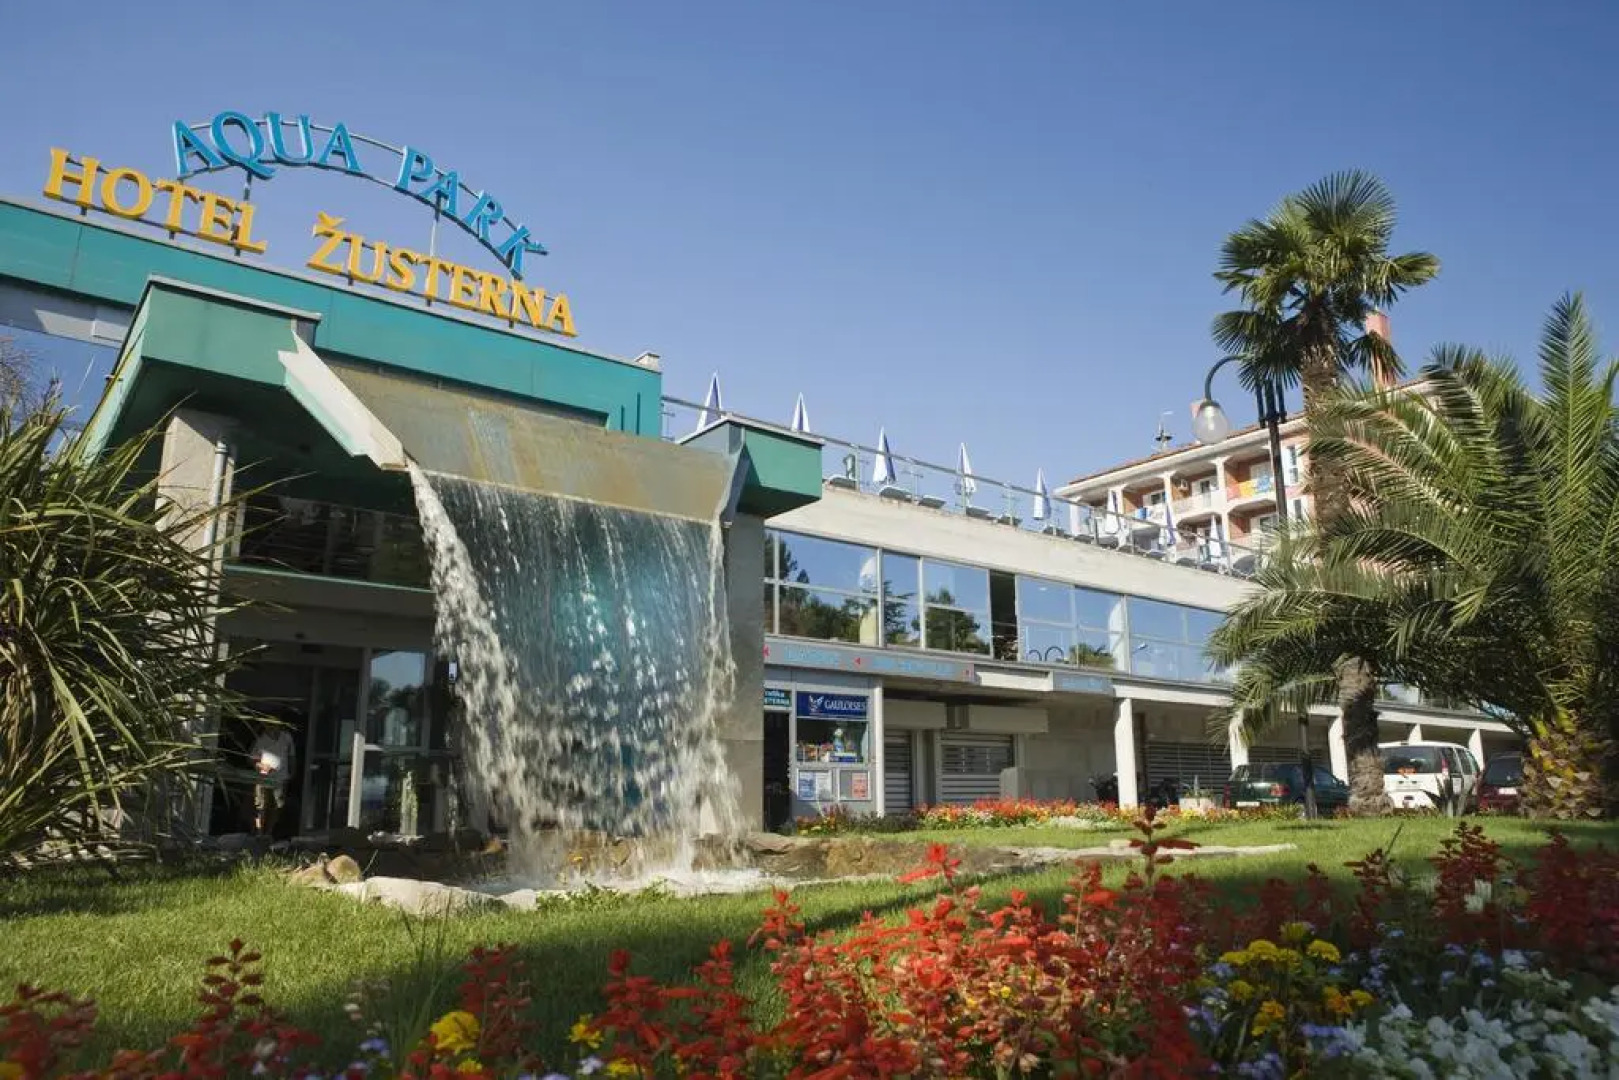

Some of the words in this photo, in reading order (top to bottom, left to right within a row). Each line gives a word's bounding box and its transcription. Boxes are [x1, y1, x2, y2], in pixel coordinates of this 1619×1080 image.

[43, 147, 267, 254] HOTEL
[306, 211, 578, 337] ŽUSTERNA
[172, 111, 362, 180] AQUA
[394, 145, 548, 279] PARK
